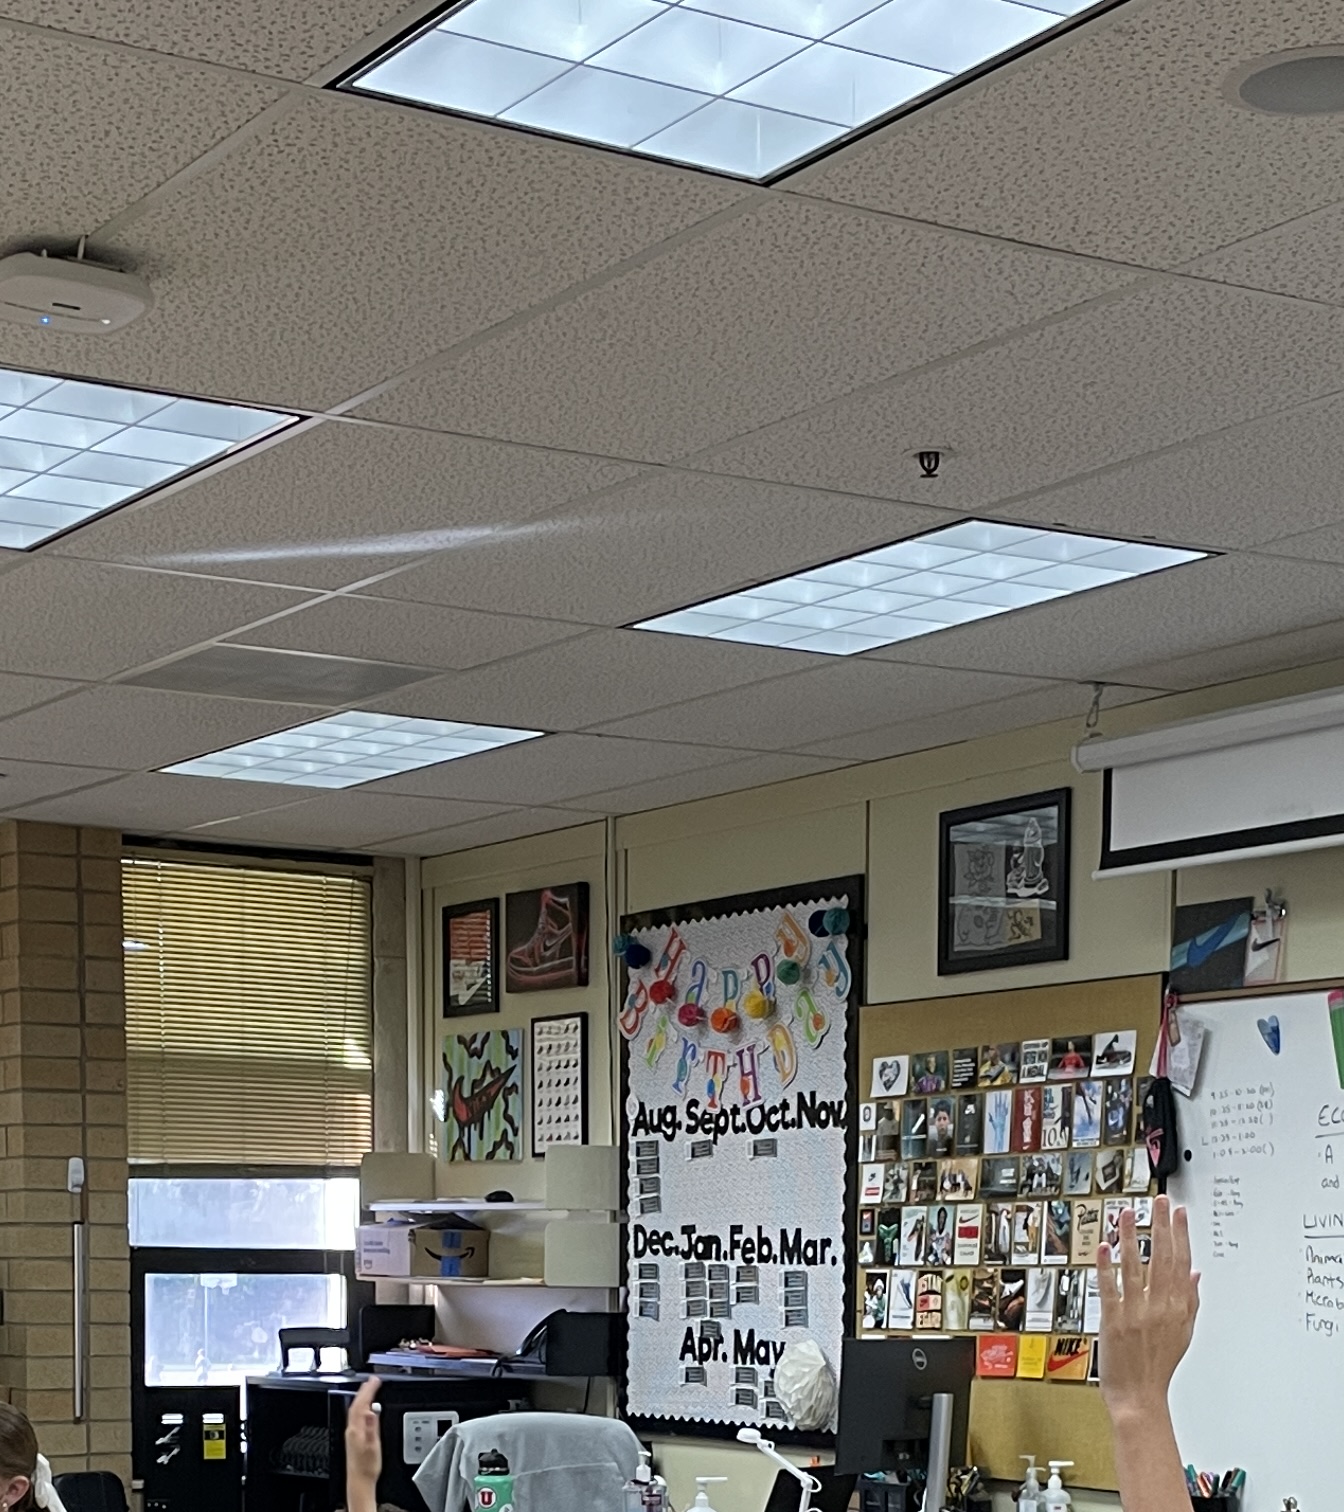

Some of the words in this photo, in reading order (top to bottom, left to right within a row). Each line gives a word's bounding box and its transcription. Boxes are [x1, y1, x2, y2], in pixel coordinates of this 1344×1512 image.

[631, 1101, 682, 1142] Aug.
[685, 1098, 746, 1146] Sept.
[746, 1098, 796, 1135] Oct.
[797, 1090, 848, 1130] Nov.
[1325, 1143, 1334, 1164] A
[1321, 1174, 1340, 1189] and
[633, 1223, 679, 1259] Dec.
[681, 1224, 729, 1261] Jan.
[729, 1224, 778, 1264] Feb.
[779, 1227, 837, 1267] Mar.
[679, 1327, 728, 1365] Apr.
